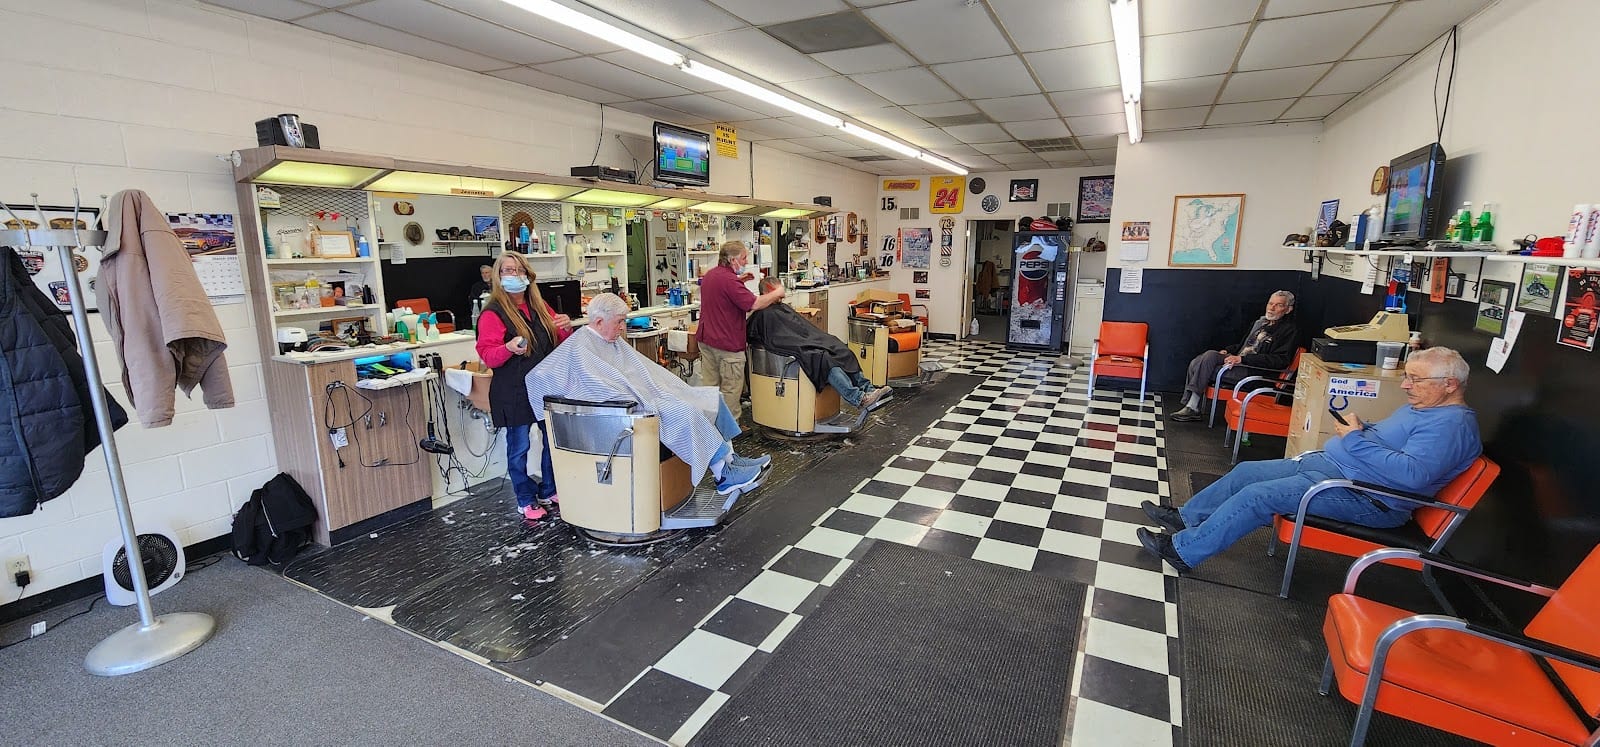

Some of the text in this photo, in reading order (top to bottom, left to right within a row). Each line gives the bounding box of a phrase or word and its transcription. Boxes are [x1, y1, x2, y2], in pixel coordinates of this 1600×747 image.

[933, 188, 960, 208] 24
[882, 237, 896, 251] 16
[881, 255, 894, 267] 16
[1331, 377, 1348, 385] God
[1329, 388, 1377, 398] America
